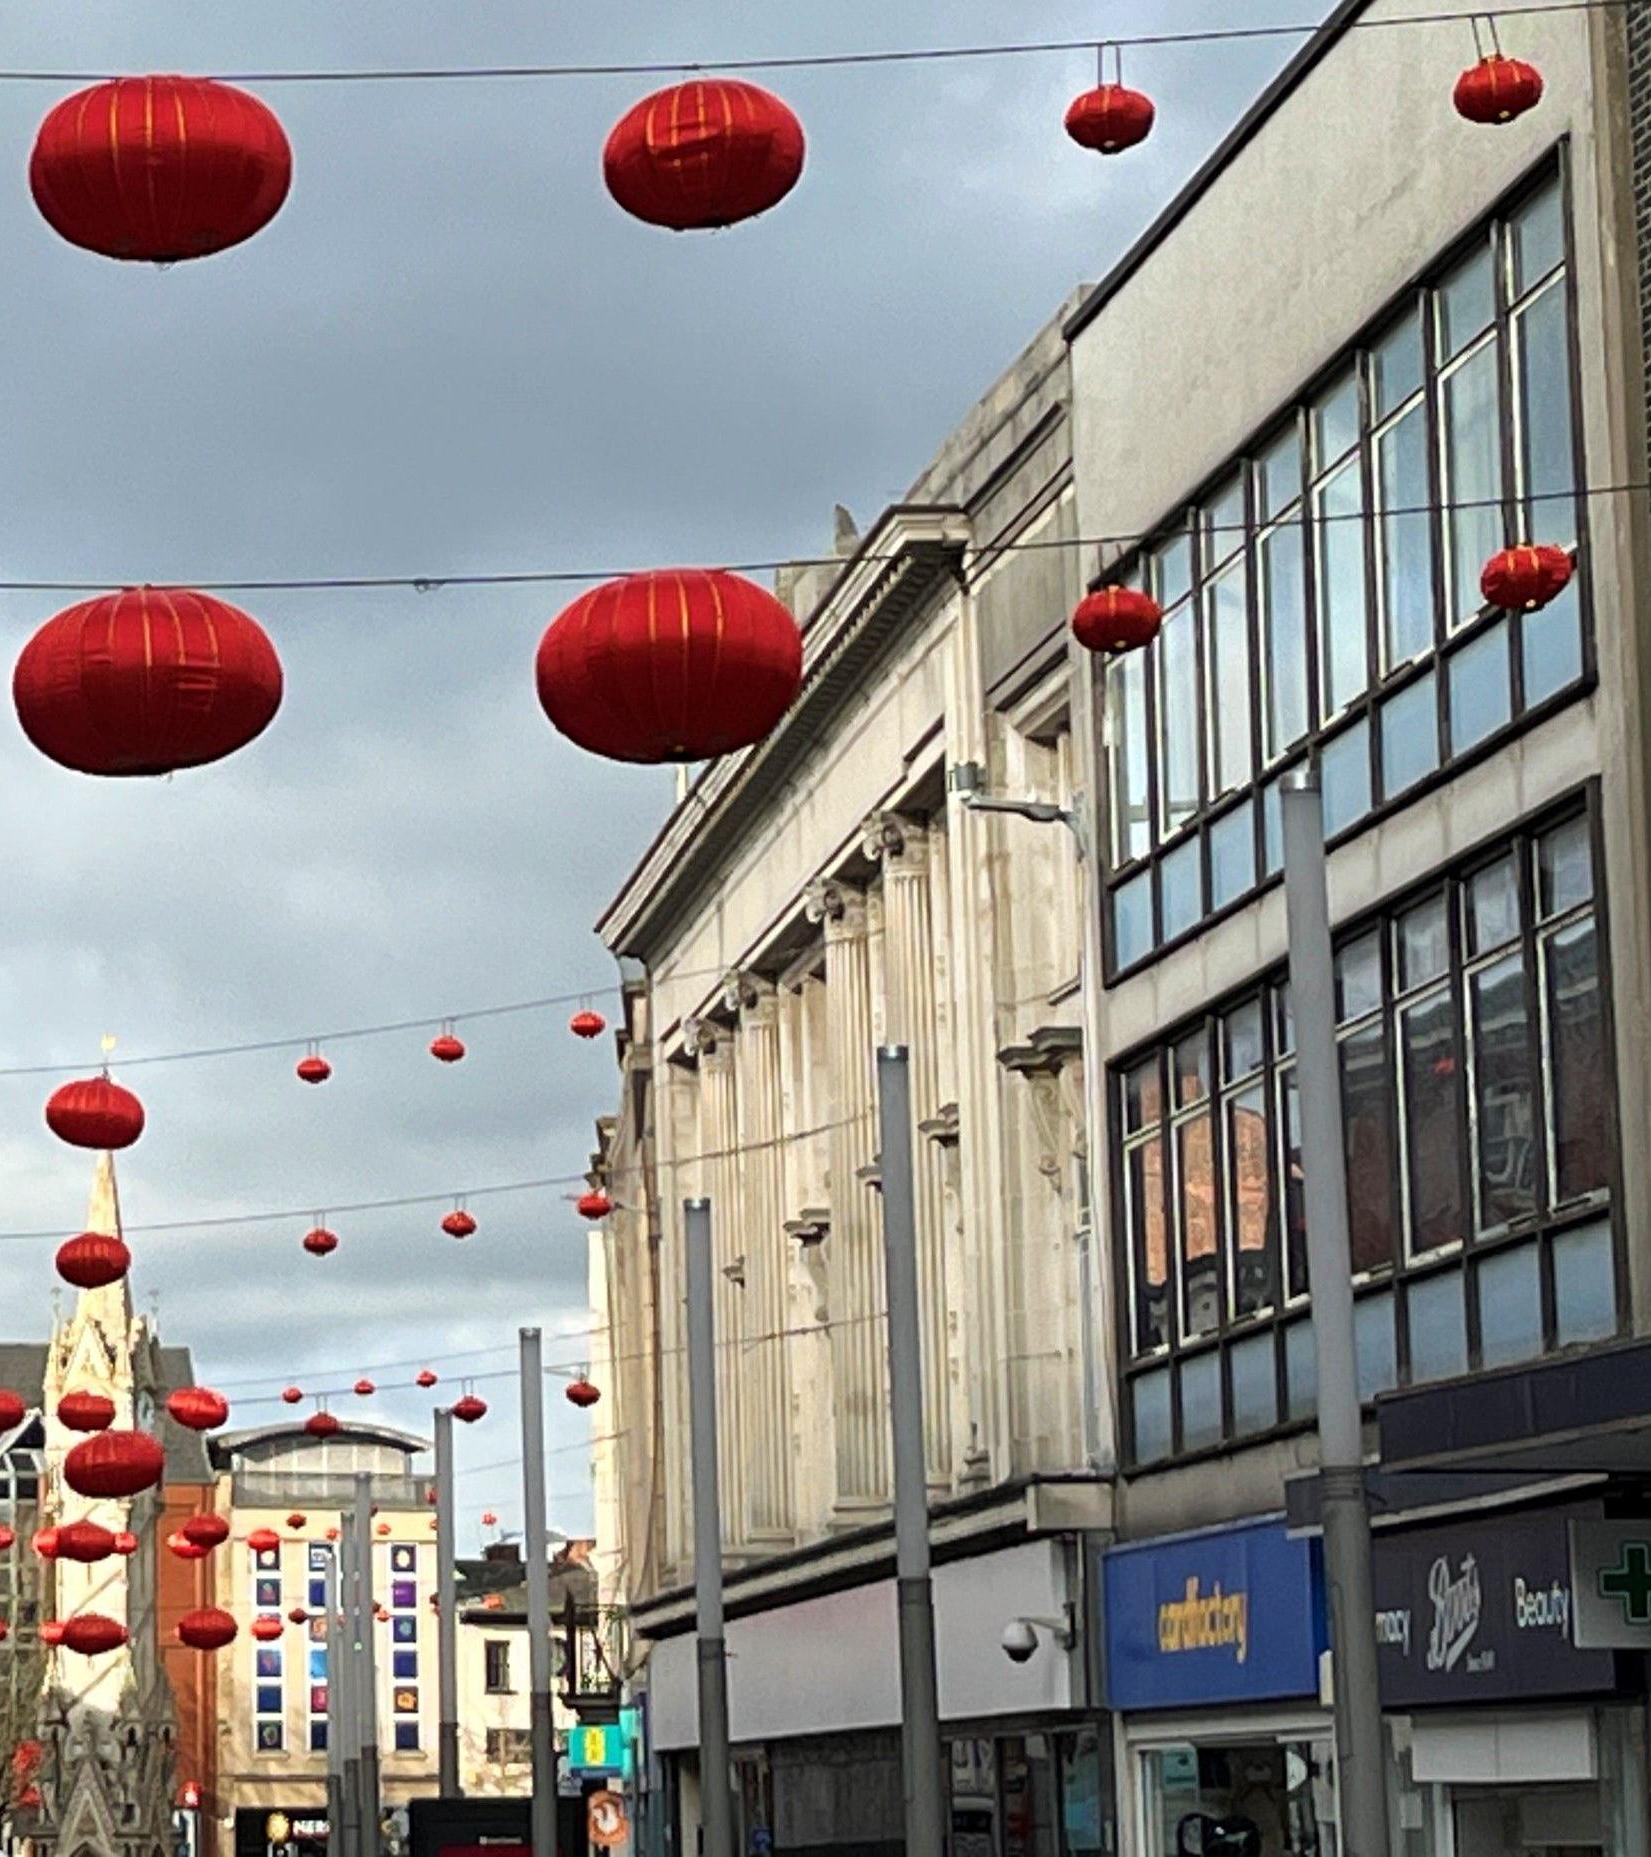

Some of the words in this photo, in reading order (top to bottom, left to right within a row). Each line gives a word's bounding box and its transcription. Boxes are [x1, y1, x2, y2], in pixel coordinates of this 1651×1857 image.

[1375, 1610, 1410, 1656] macy
[1427, 1552, 1481, 1672] Boots
[1514, 1577, 1570, 1639] Beauty
